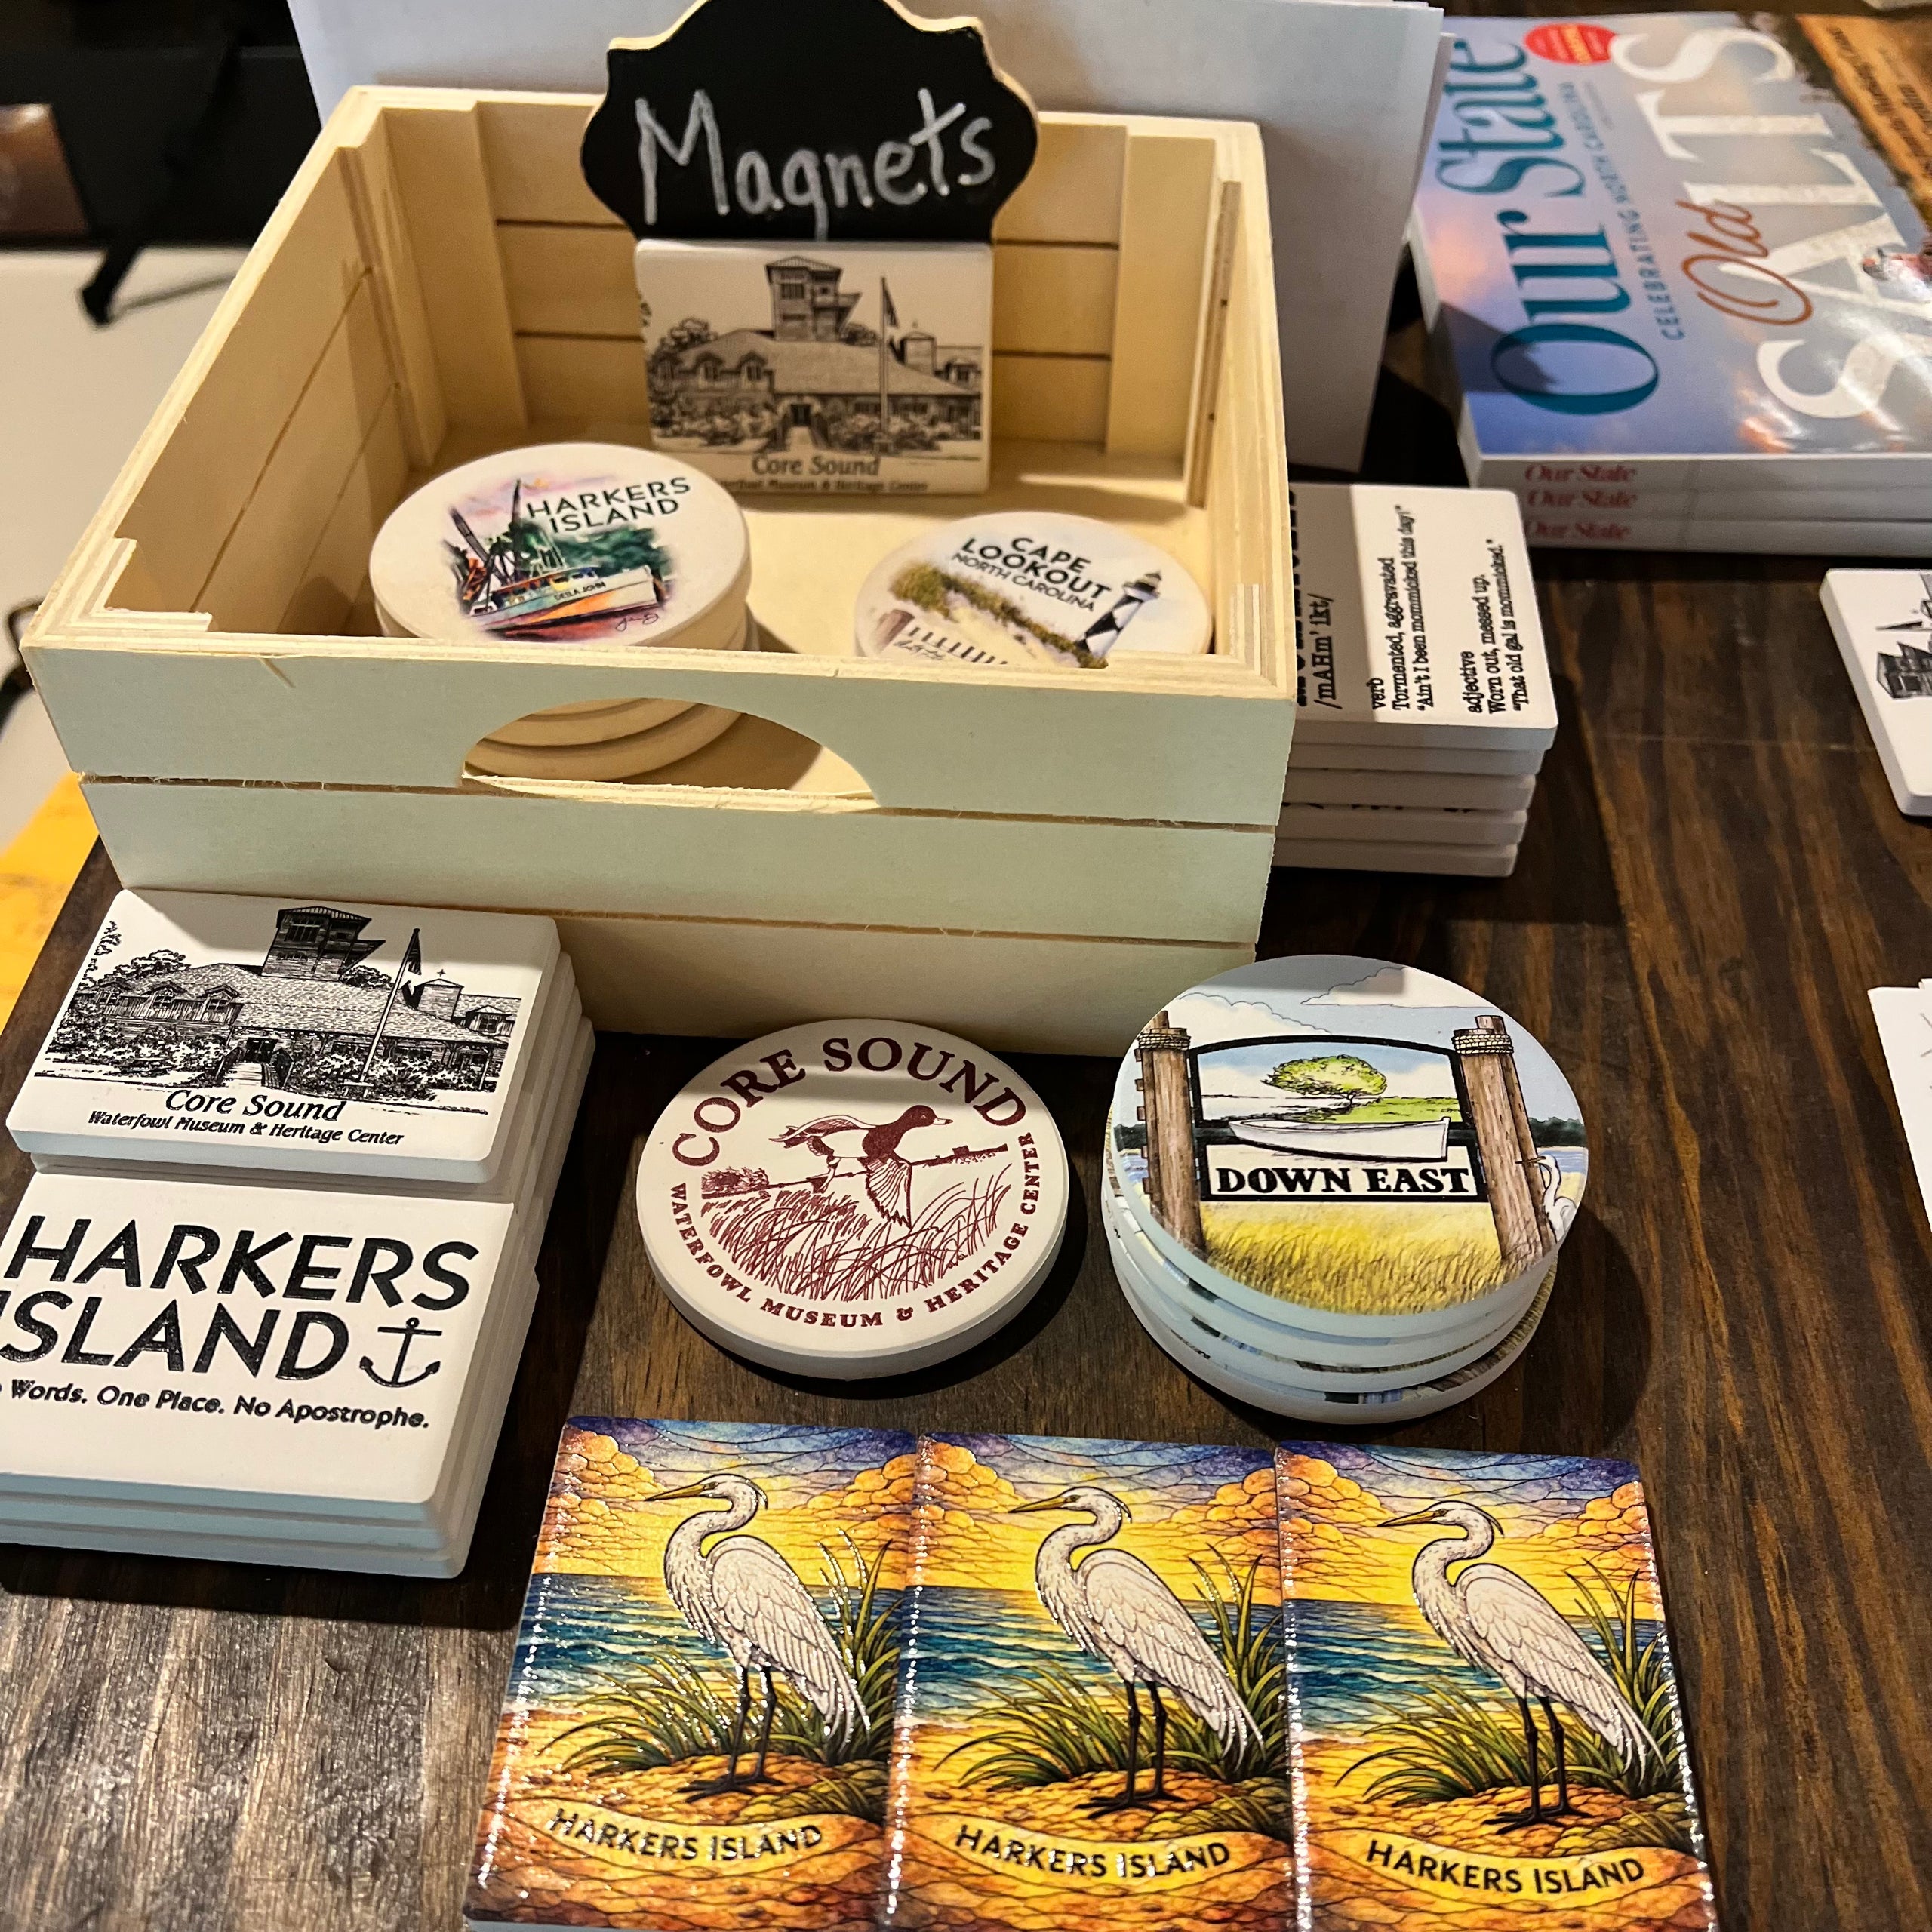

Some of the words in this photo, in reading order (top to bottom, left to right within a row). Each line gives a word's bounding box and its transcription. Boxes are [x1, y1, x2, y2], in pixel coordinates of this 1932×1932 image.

[1437, 39, 1586, 198] State
[635, 86, 997, 241] Magnets
[1608, 28, 1932, 418] SALTS
[1617, 209, 1685, 340] CELEBRATING
[1673, 198, 1813, 325] Old
[1490, 208, 1659, 416] Our
[751, 455, 803, 475] Core
[810, 454, 881, 475] Sound
[526, 477, 690, 518] HARKERS
[549, 498, 678, 533] ISLAND
[952, 552, 1011, 580] NORTH
[1012, 575, 1094, 612] CAROLINA
[961, 537, 1112, 599] LOOKOUT
[1011, 537, 1091, 574] CAPE
[1377, 557, 1404, 629] aggravated
[1472, 596, 1495, 645] messed
[1412, 635, 1429, 666] been
[1500, 619, 1516, 629] is
[1501, 633, 1524, 651] gal
[1385, 632, 1410, 711] Tormented,
[1459, 651, 1484, 714] adjective
[1481, 648, 1500, 674] out,
[1505, 654, 1524, 673] old
[1366, 678, 1386, 711] verb
[1487, 676, 1506, 714] Worn
[88, 1109, 173, 1131] Waterfowl
[174, 1117, 246, 1135] Museum
[250, 1121, 268, 1136] &
[272, 1123, 344, 1144] Heritage
[347, 1129, 405, 1146] Center
[165, 1089, 237, 1115] Core
[242, 1094, 348, 1122] Sound
[672, 1048, 806, 1167] CORE
[823, 1037, 1026, 1127] SOUND
[1216, 1166, 1351, 1194] DOWN
[1366, 1167, 1470, 1194] EAST
[670, 1182, 752, 1303] WATERFOWL
[759, 1297, 884, 1328] MUSEUM
[895, 1306, 914, 1321] &
[923, 1223, 1029, 1314] HERITAGE
[1018, 1131, 1041, 1217] CENTER
[3, 1214, 480, 1312] HARKERS
[0, 1289, 350, 1381] SLAND
[11, 1379, 88, 1404] Words.
[97, 1386, 150, 1408] One
[155, 1389, 225, 1414] Place.
[233, 1395, 271, 1417] No
[275, 1398, 429, 1430] Apostrophe.
[549, 1807, 697, 1860] HARKERS
[706, 1823, 823, 1862] ISLAND
[955, 1823, 1107, 1878] HARKERS
[1115, 1842, 1230, 1878] ISLAND
[1366, 1839, 1523, 1894] HARKERS
[1534, 1858, 1645, 1894] ISLAND
